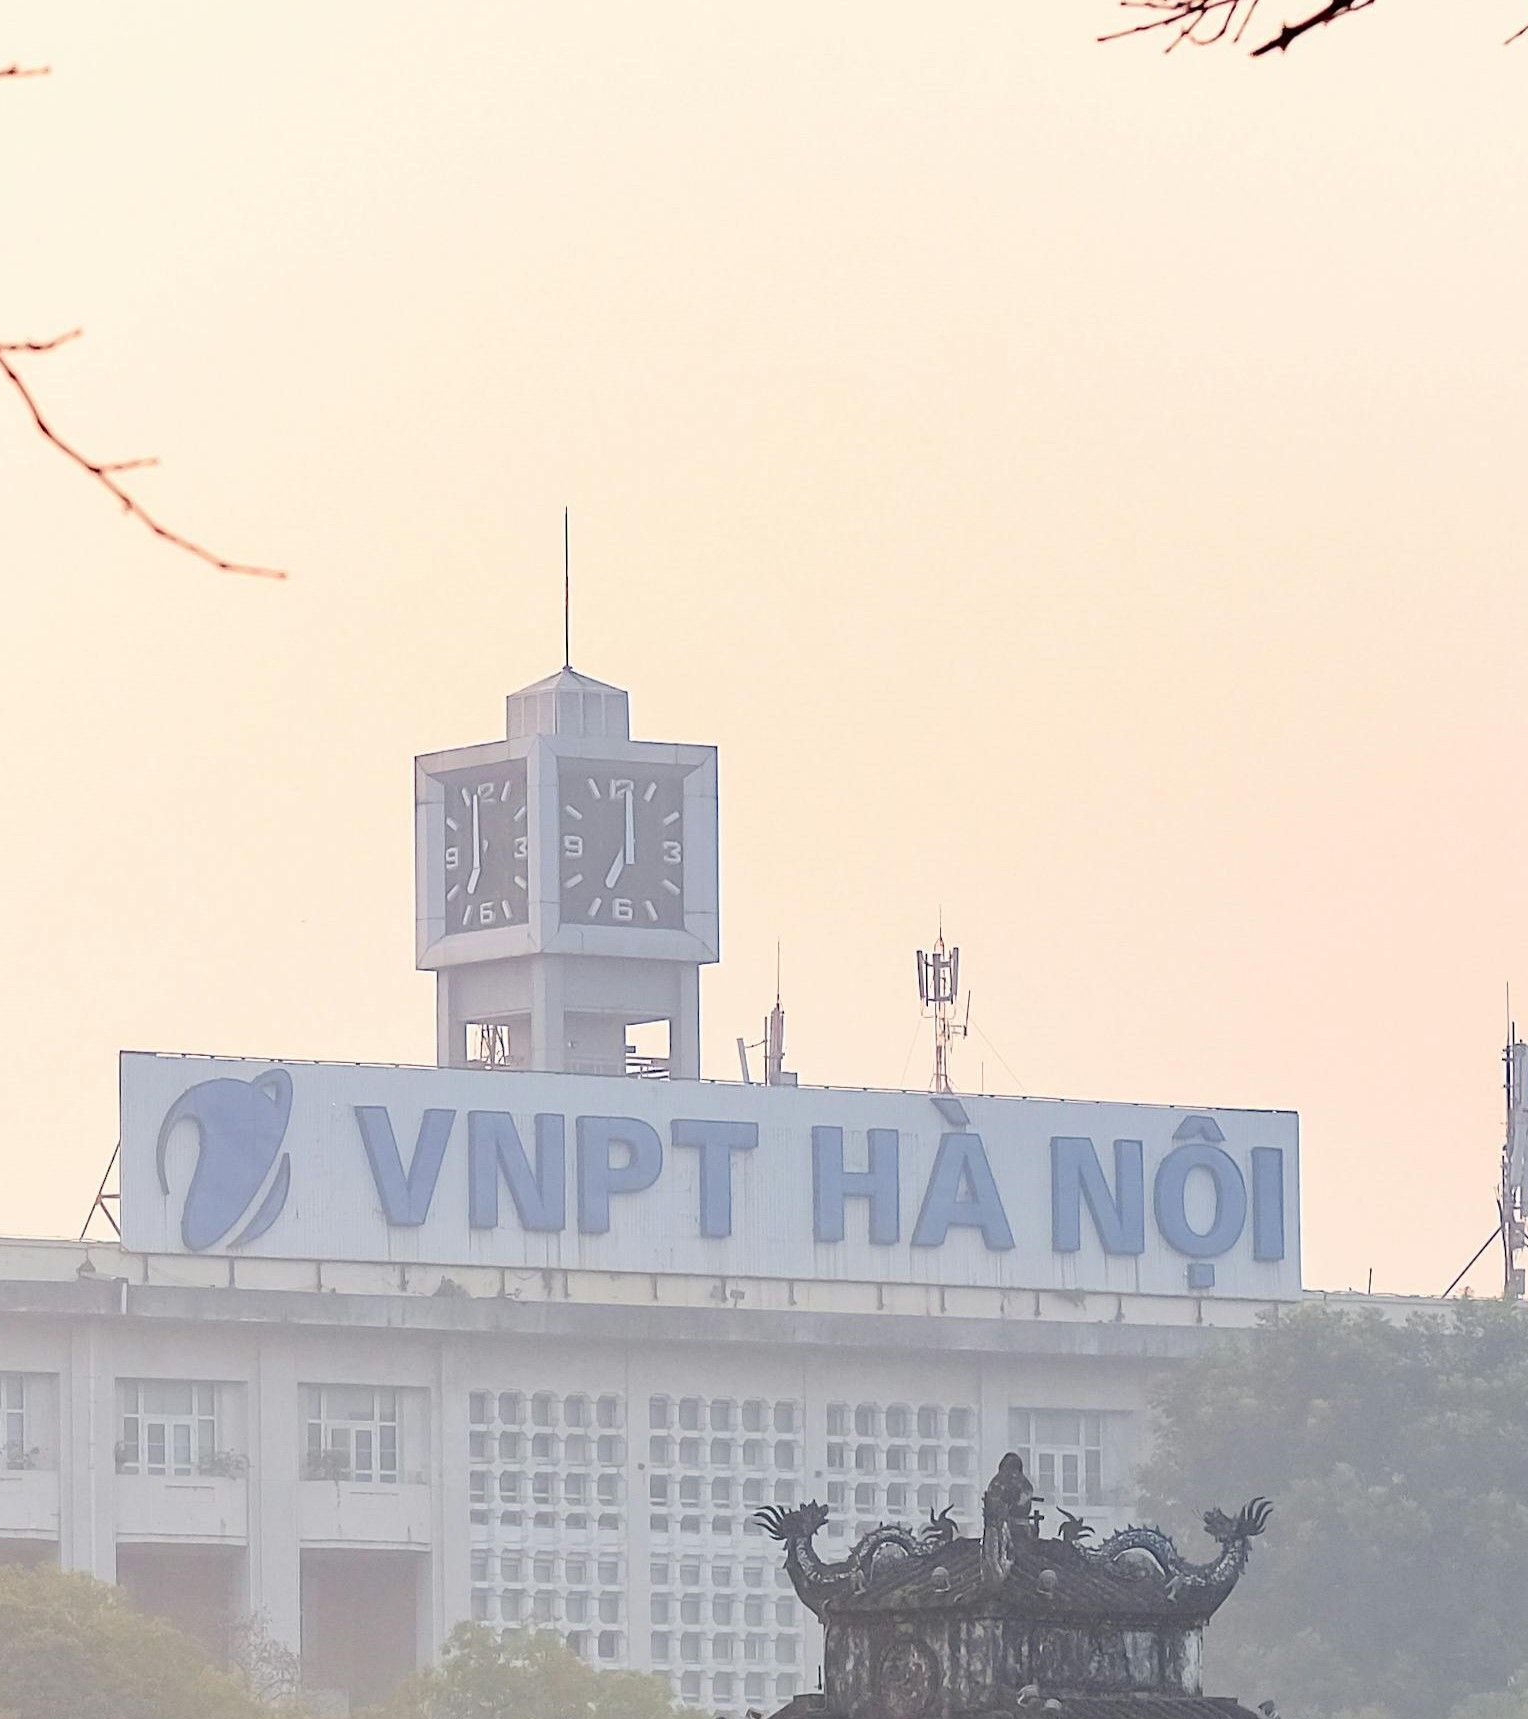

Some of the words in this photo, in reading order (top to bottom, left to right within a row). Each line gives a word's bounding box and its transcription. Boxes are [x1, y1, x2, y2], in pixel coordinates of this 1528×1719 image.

[513, 836, 528, 858] 3
[564, 835, 583, 857] 9
[663, 841, 682, 864] 3
[444, 847, 458, 869] 9
[479, 901, 495, 923] 6
[612, 898, 633, 921] 6
[354, 1105, 759, 1239] VNPT
[811, 1097, 1016, 1251] HÀ
[1049, 1115, 1285, 1289] NỘI
